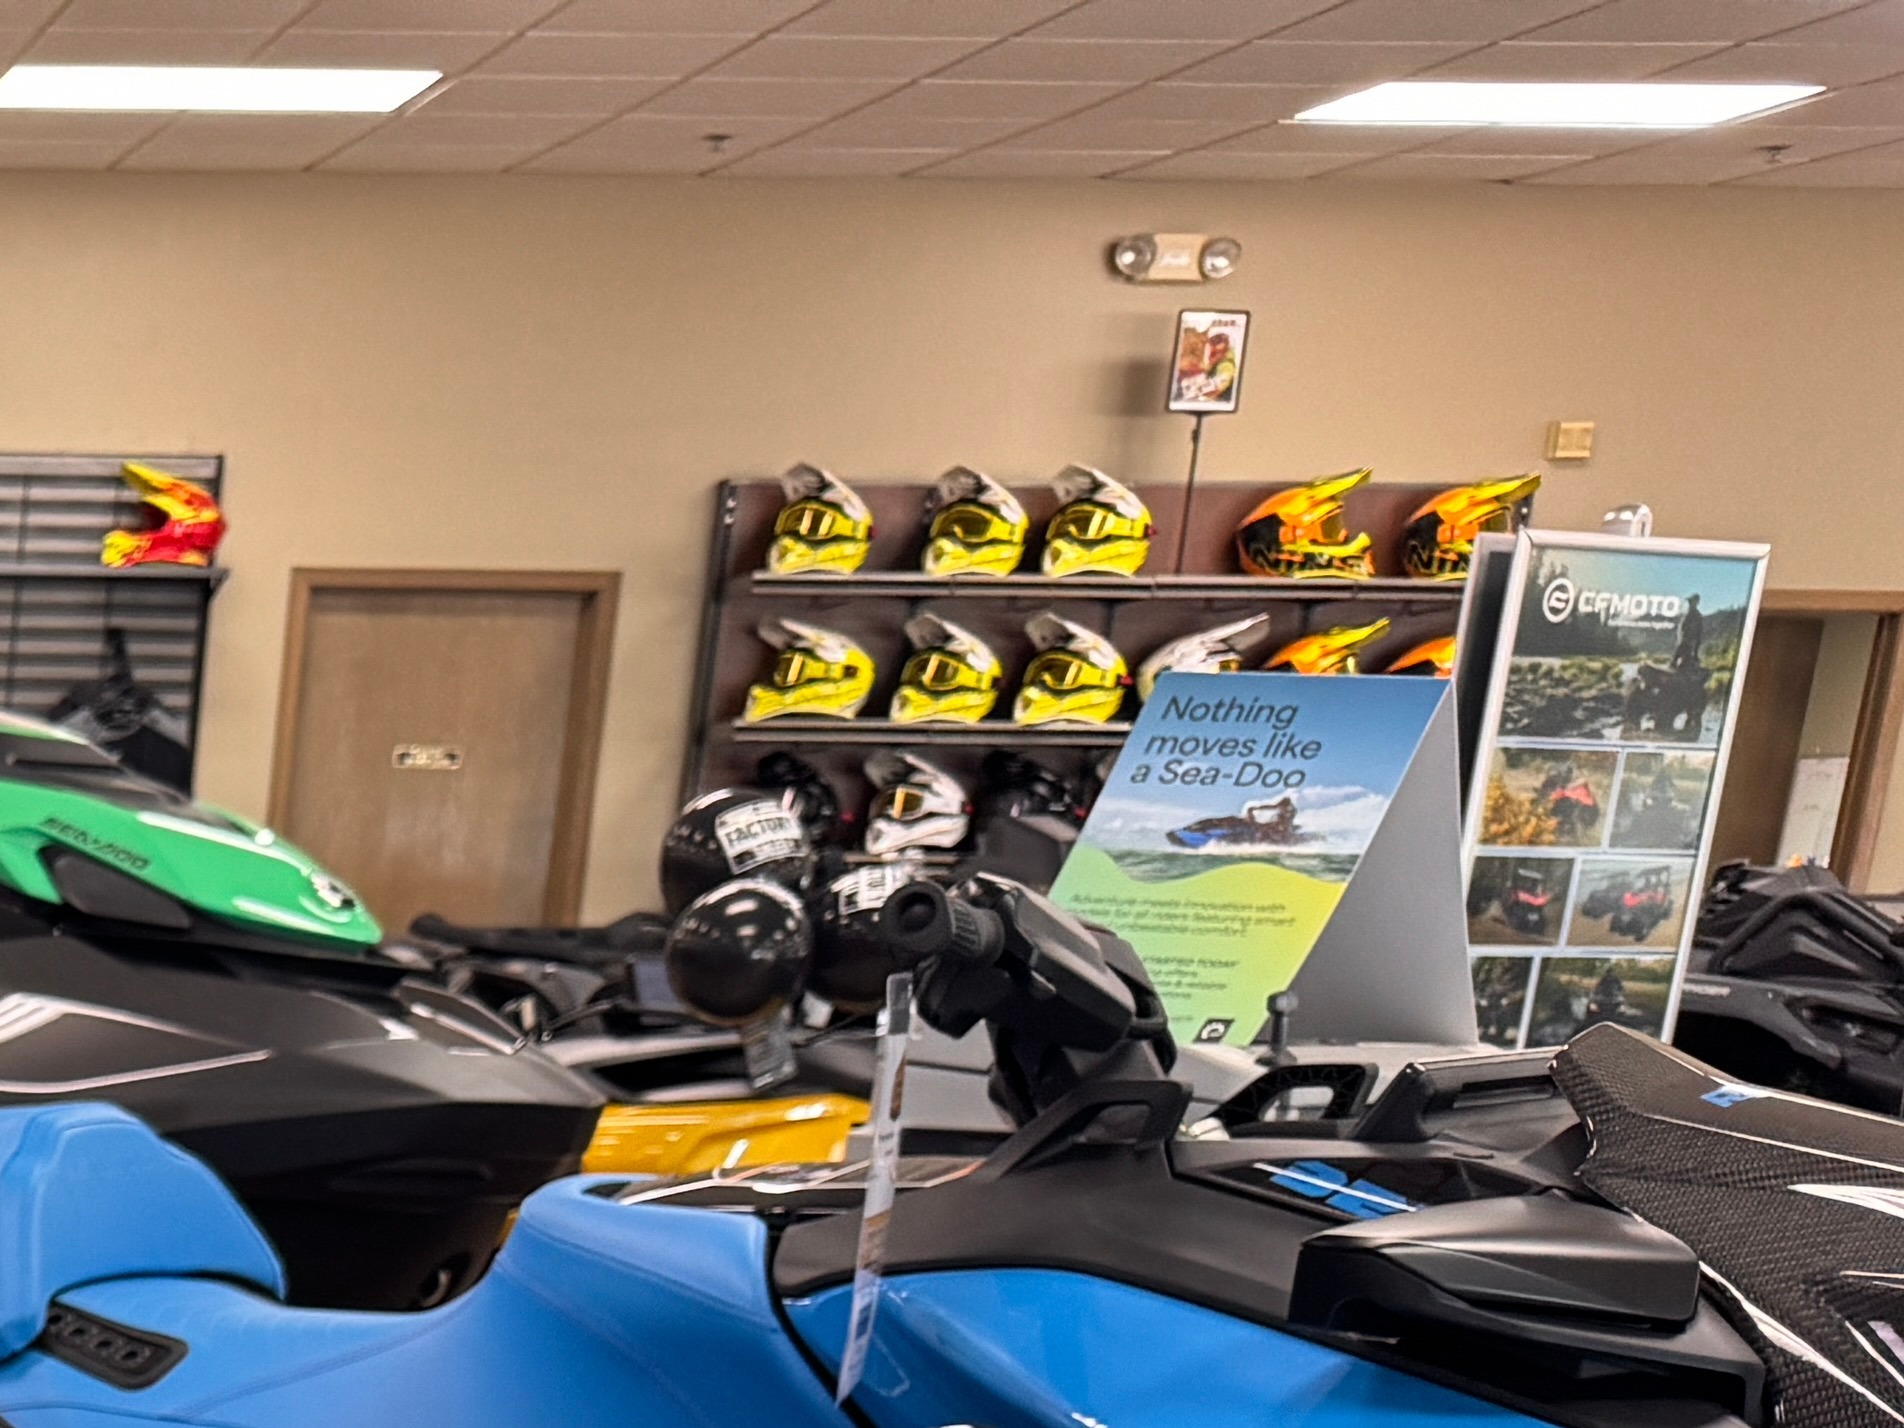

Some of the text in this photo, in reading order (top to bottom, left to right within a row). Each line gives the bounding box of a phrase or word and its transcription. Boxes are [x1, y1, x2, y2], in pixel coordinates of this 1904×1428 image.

[1577, 591, 1681, 617] CFMOTO
[1160, 693, 1298, 731] Nothing
[1143, 731, 1323, 761] moves like
[1130, 758, 1307, 789] a Sea-Doo
